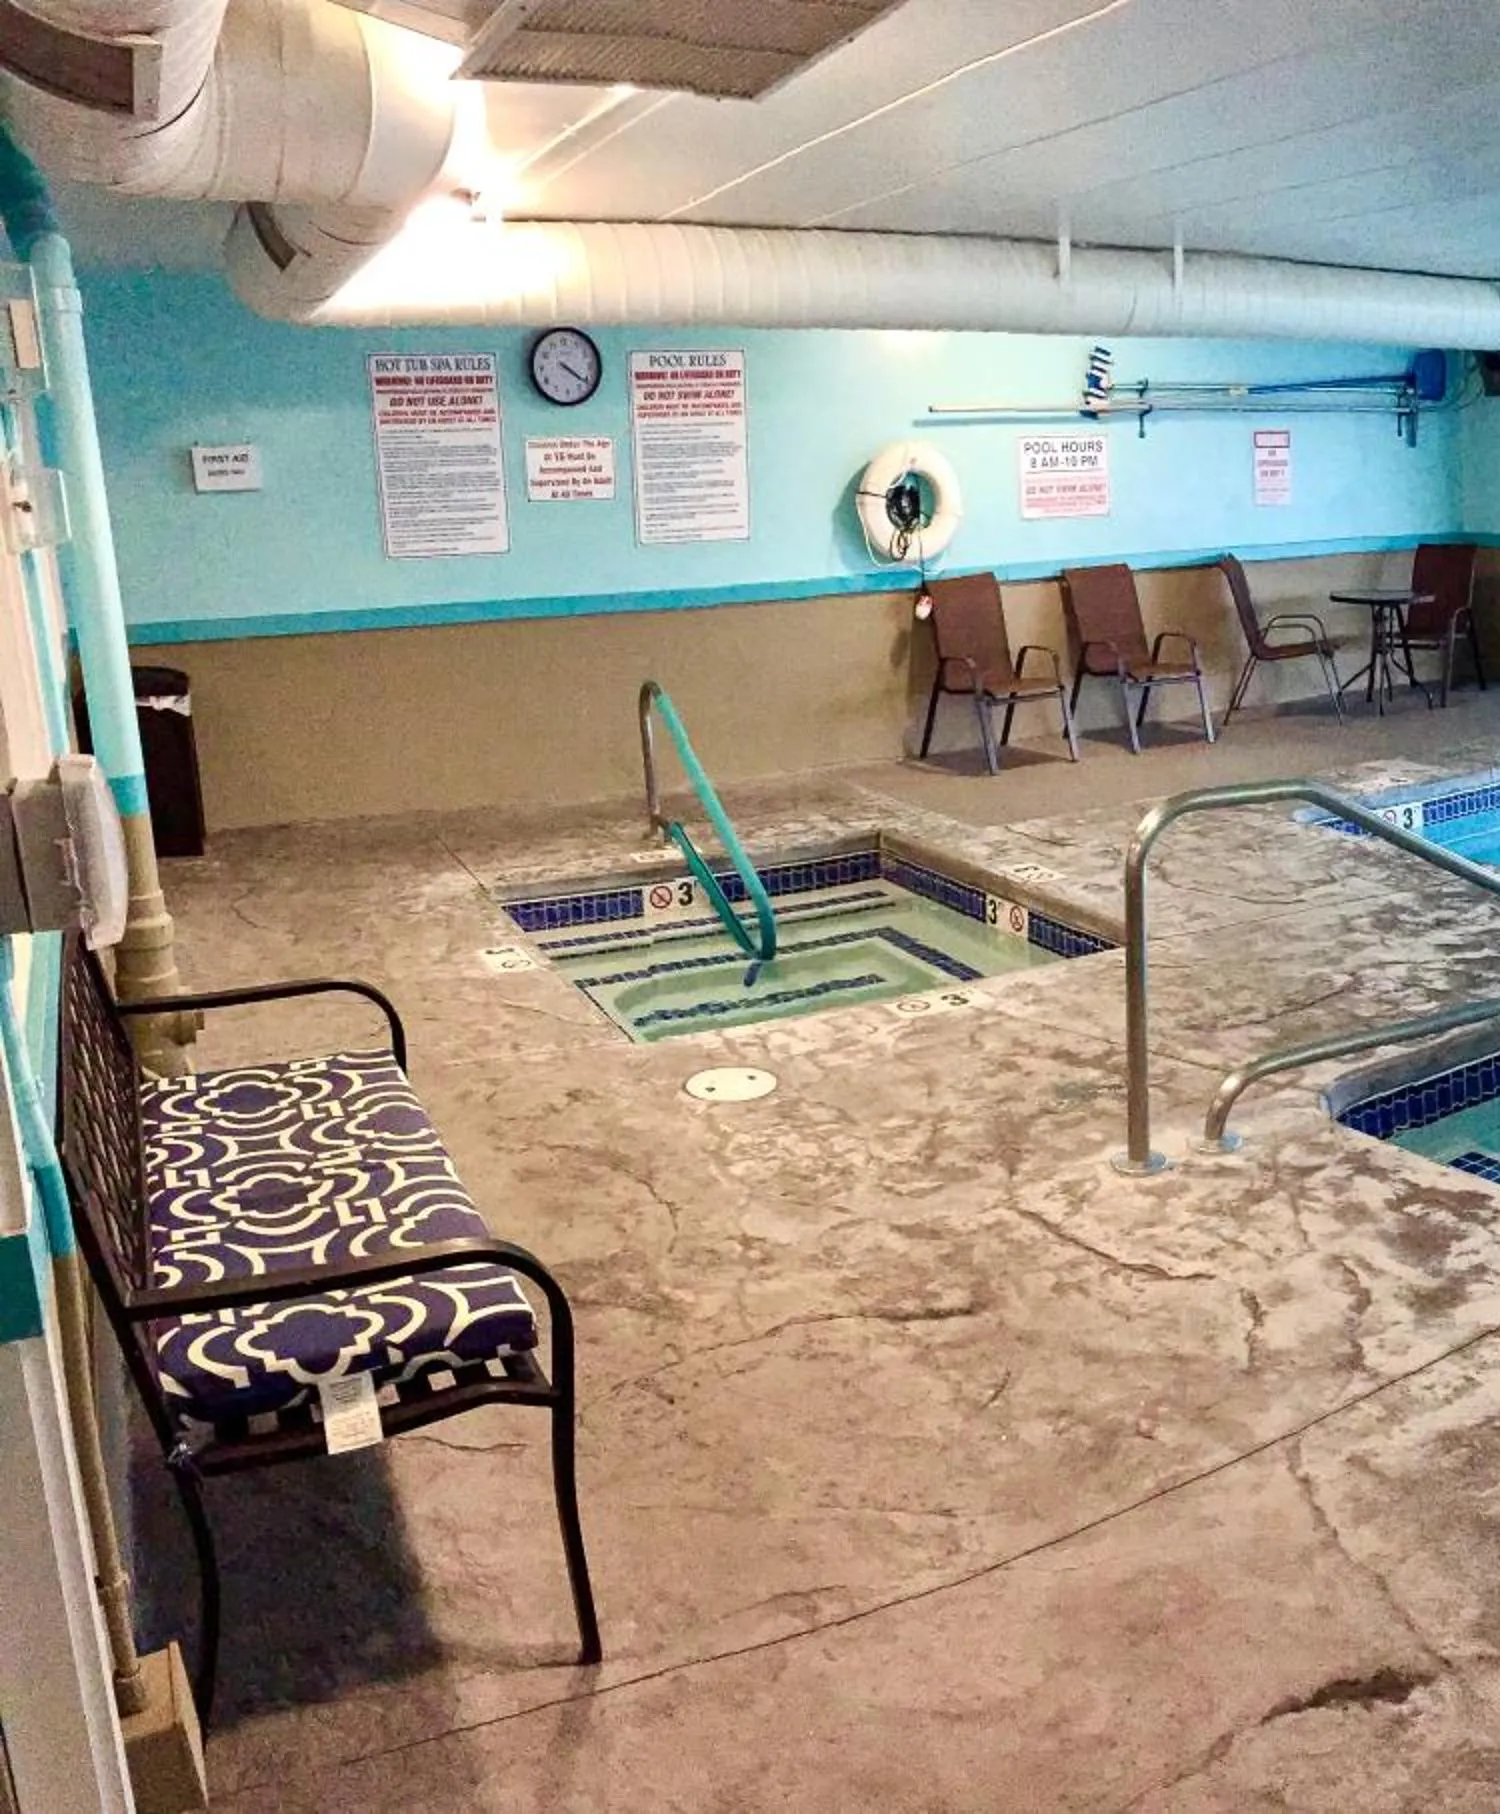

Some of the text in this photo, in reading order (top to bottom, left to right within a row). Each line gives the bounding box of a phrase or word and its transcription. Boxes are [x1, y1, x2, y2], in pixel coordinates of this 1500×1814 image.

[375, 357, 491, 372] HOT TUB SPA RULES
[649, 353, 727, 367] POOL RULES
[1023, 439, 1103, 454] POOL HOURS
[1080, 455, 1098, 467] PM
[1403, 807, 1413, 830] 3
[678, 881, 693, 906] 3
[988, 899, 998, 925] 3
